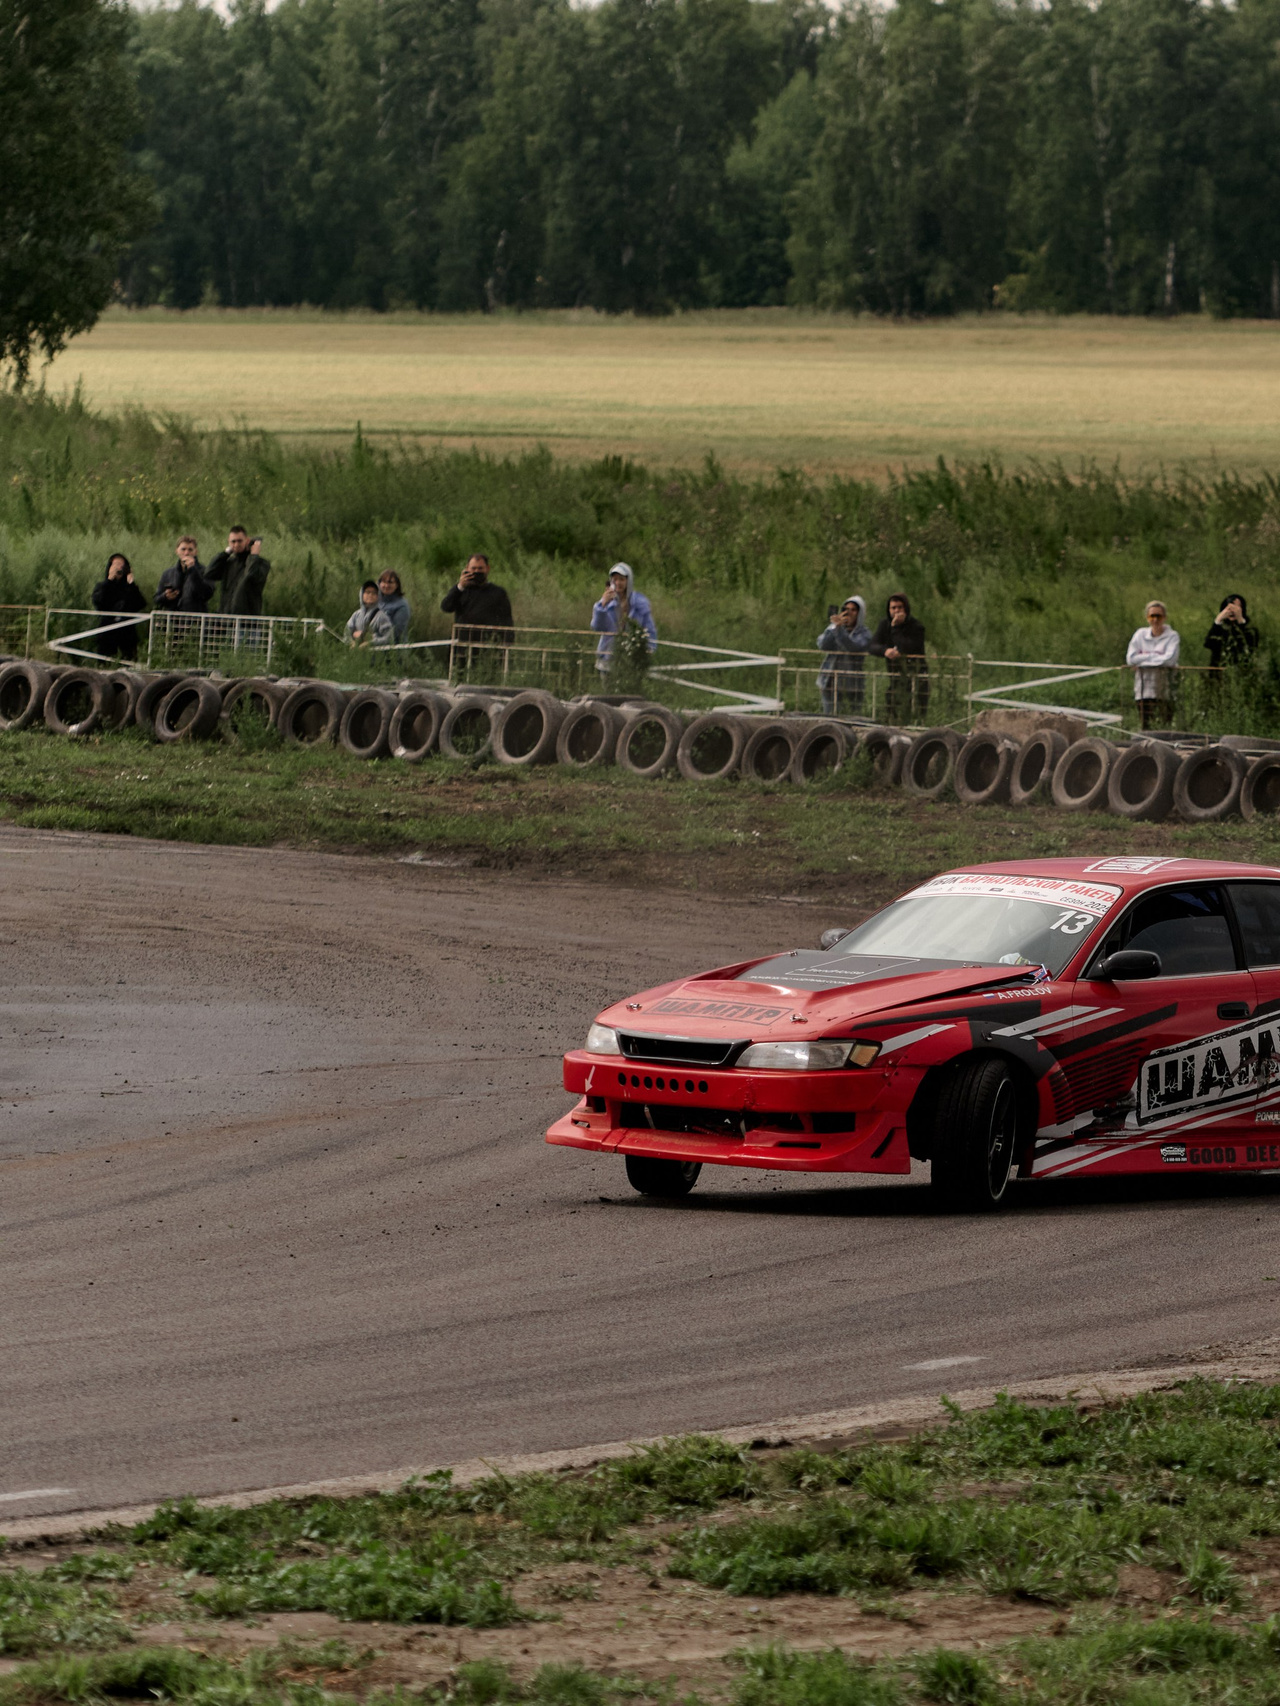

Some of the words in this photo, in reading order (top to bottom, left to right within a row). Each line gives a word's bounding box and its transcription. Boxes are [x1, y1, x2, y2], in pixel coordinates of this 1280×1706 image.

[959, 875, 1066, 890] БАРНАУЛЬСКОЙ
[1059, 896, 1086, 906] СЕЗОН
[1049, 910, 1094, 935] 13
[997, 986, 1052, 1000] A.FROLOV
[655, 1000, 782, 1021] ШАМПУР
[1190, 1147, 1236, 1165] GOOD
